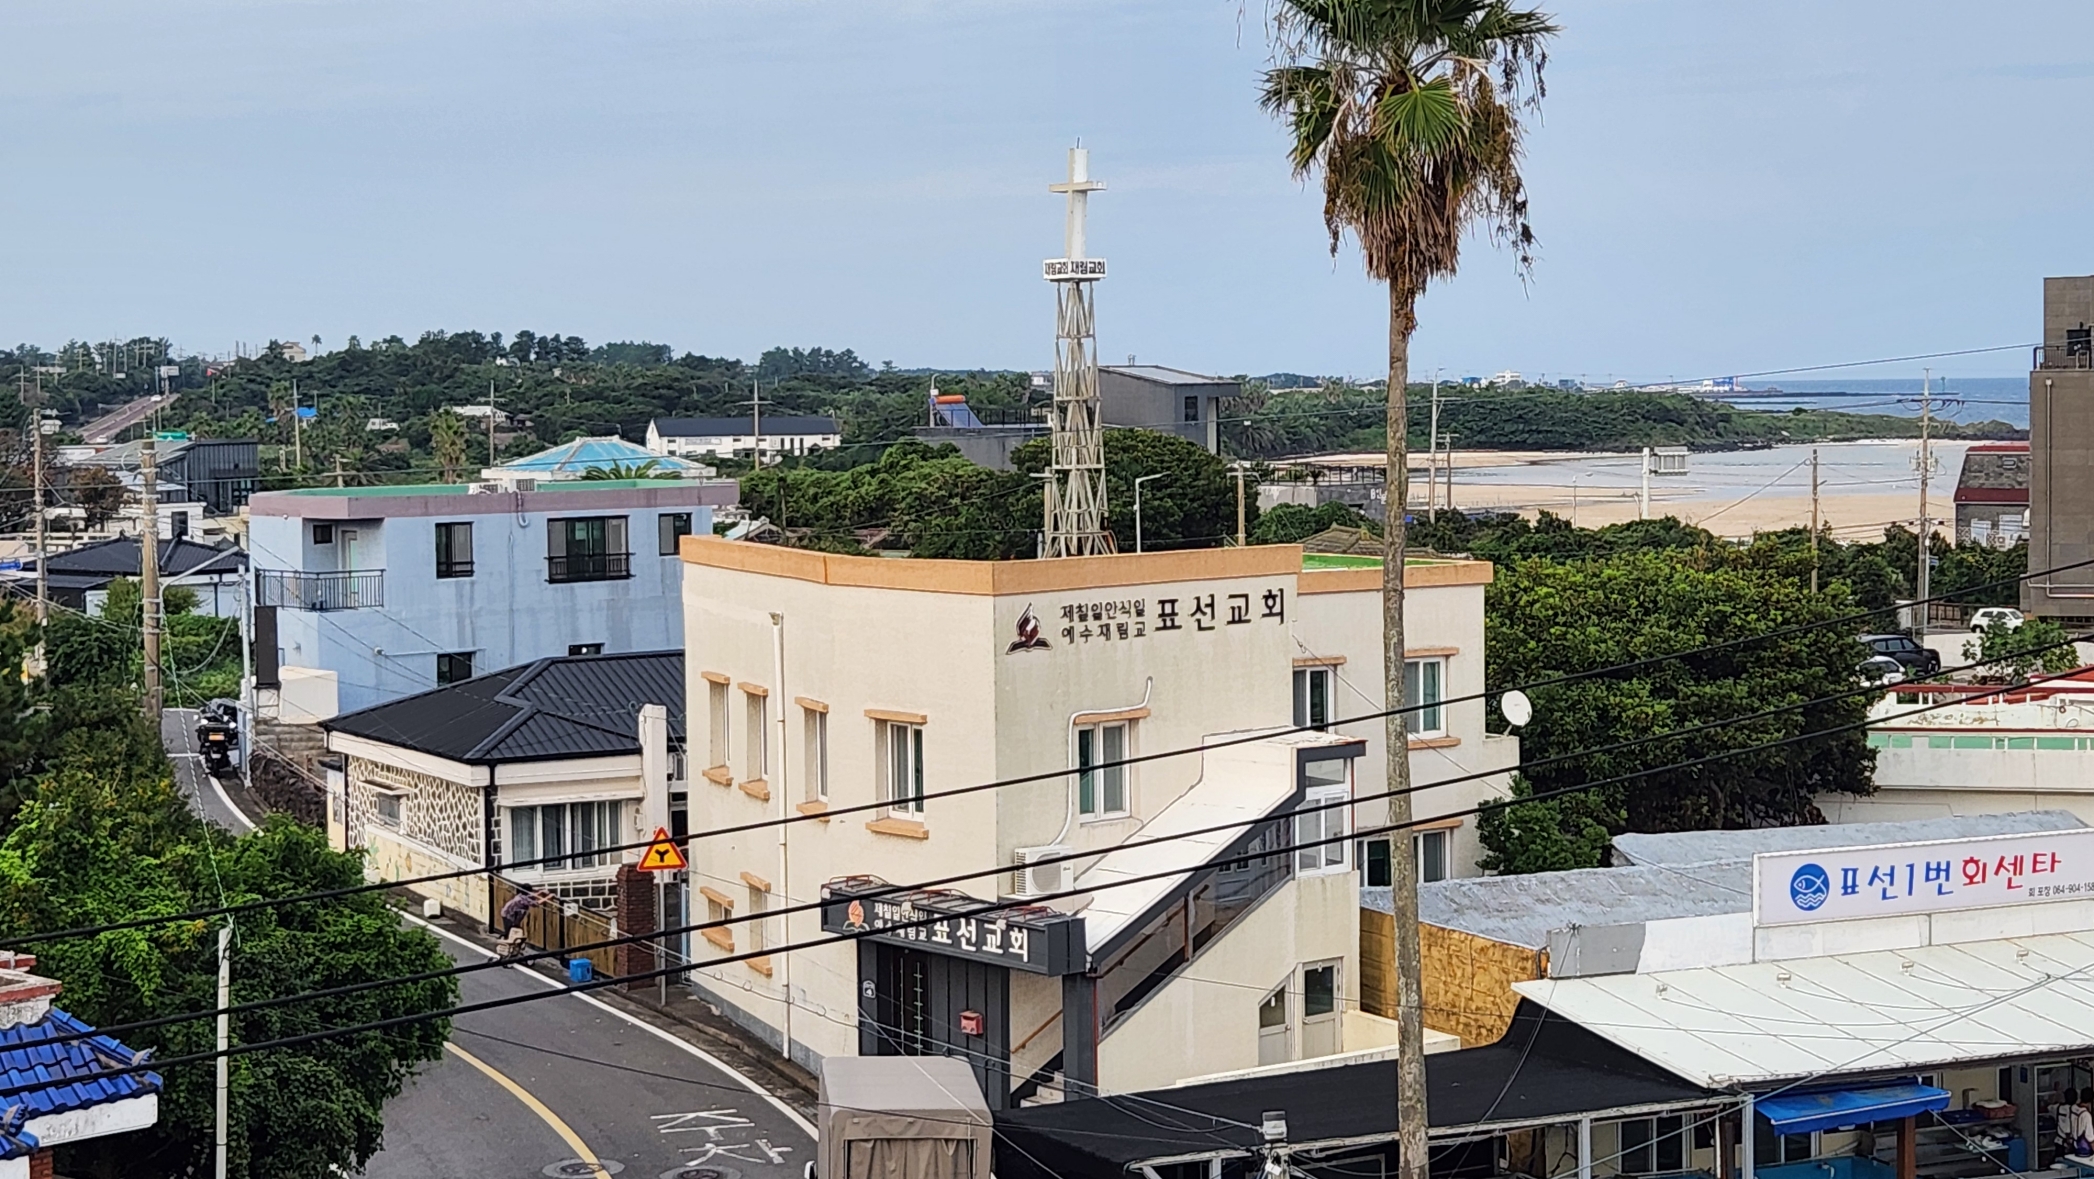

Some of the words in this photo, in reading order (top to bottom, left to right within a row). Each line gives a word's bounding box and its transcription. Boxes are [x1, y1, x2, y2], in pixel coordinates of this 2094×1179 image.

[1070, 260, 1105, 274] 재림교회
[1060, 598, 1146, 622] 제칠일안식일
[1154, 588, 1285, 632] 표선교회
[1061, 621, 1147, 645] 예수재림교
[931, 913, 1028, 963] 표선교회
